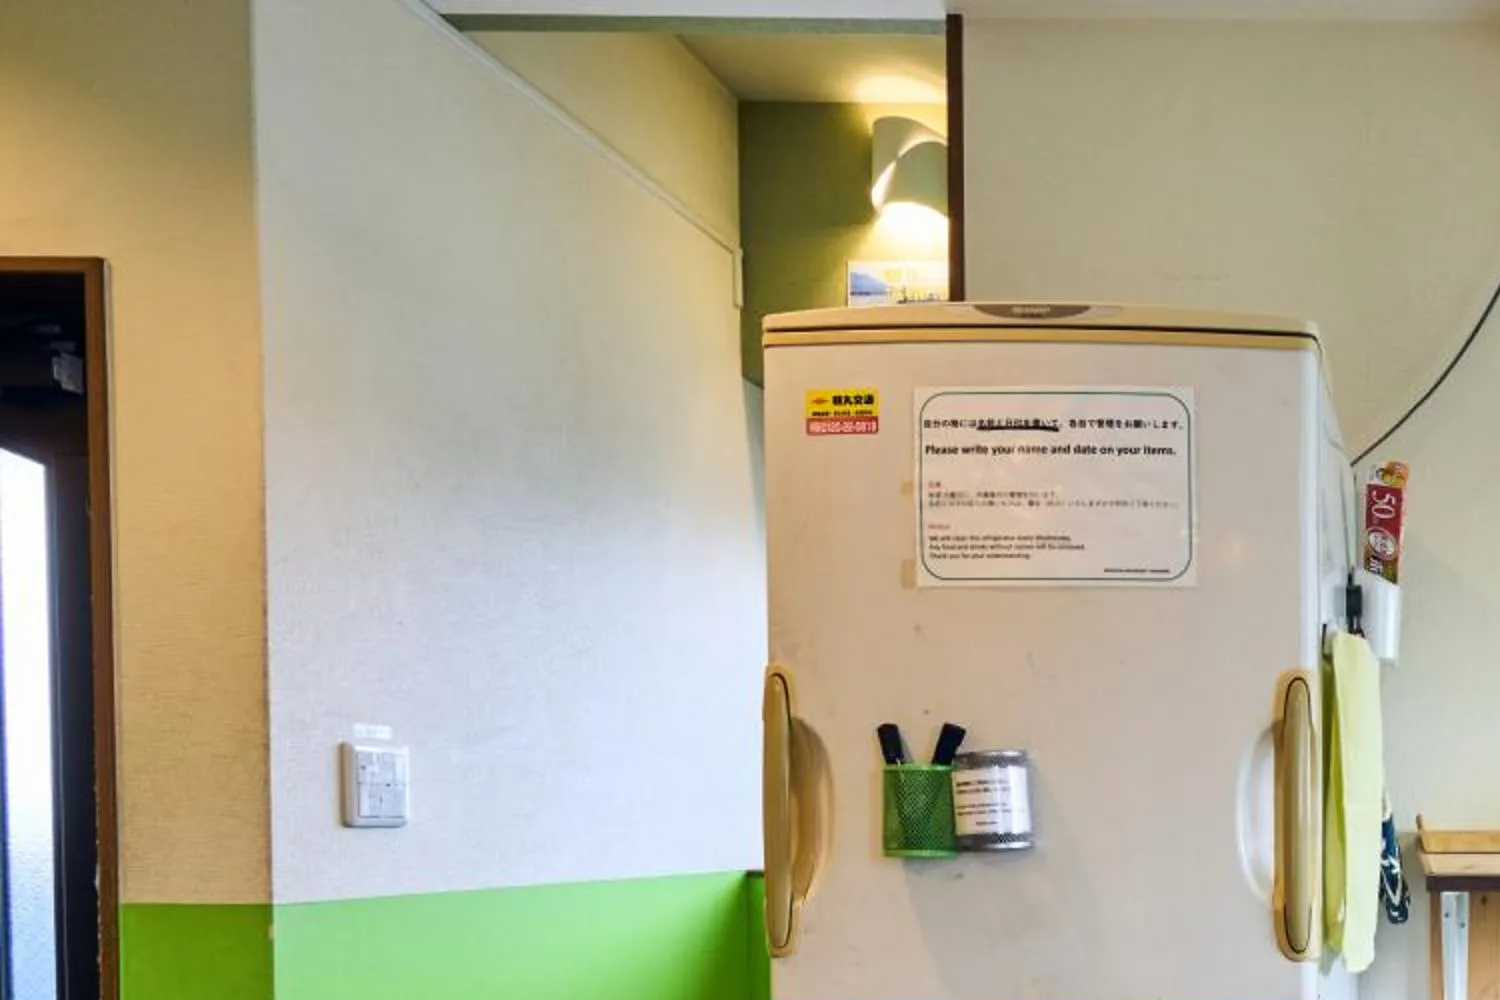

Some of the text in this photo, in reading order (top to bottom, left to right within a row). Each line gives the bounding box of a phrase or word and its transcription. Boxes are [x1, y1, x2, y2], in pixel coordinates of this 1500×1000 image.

[925, 445, 959, 455] Please
[961, 445, 988, 455] write
[991, 447, 1015, 457] your
[1017, 446, 1048, 455] name
[1050, 445, 1071, 455] and
[1073, 445, 1098, 455] date
[1099, 446, 1114, 455] on
[1116, 446, 1141, 456] your
